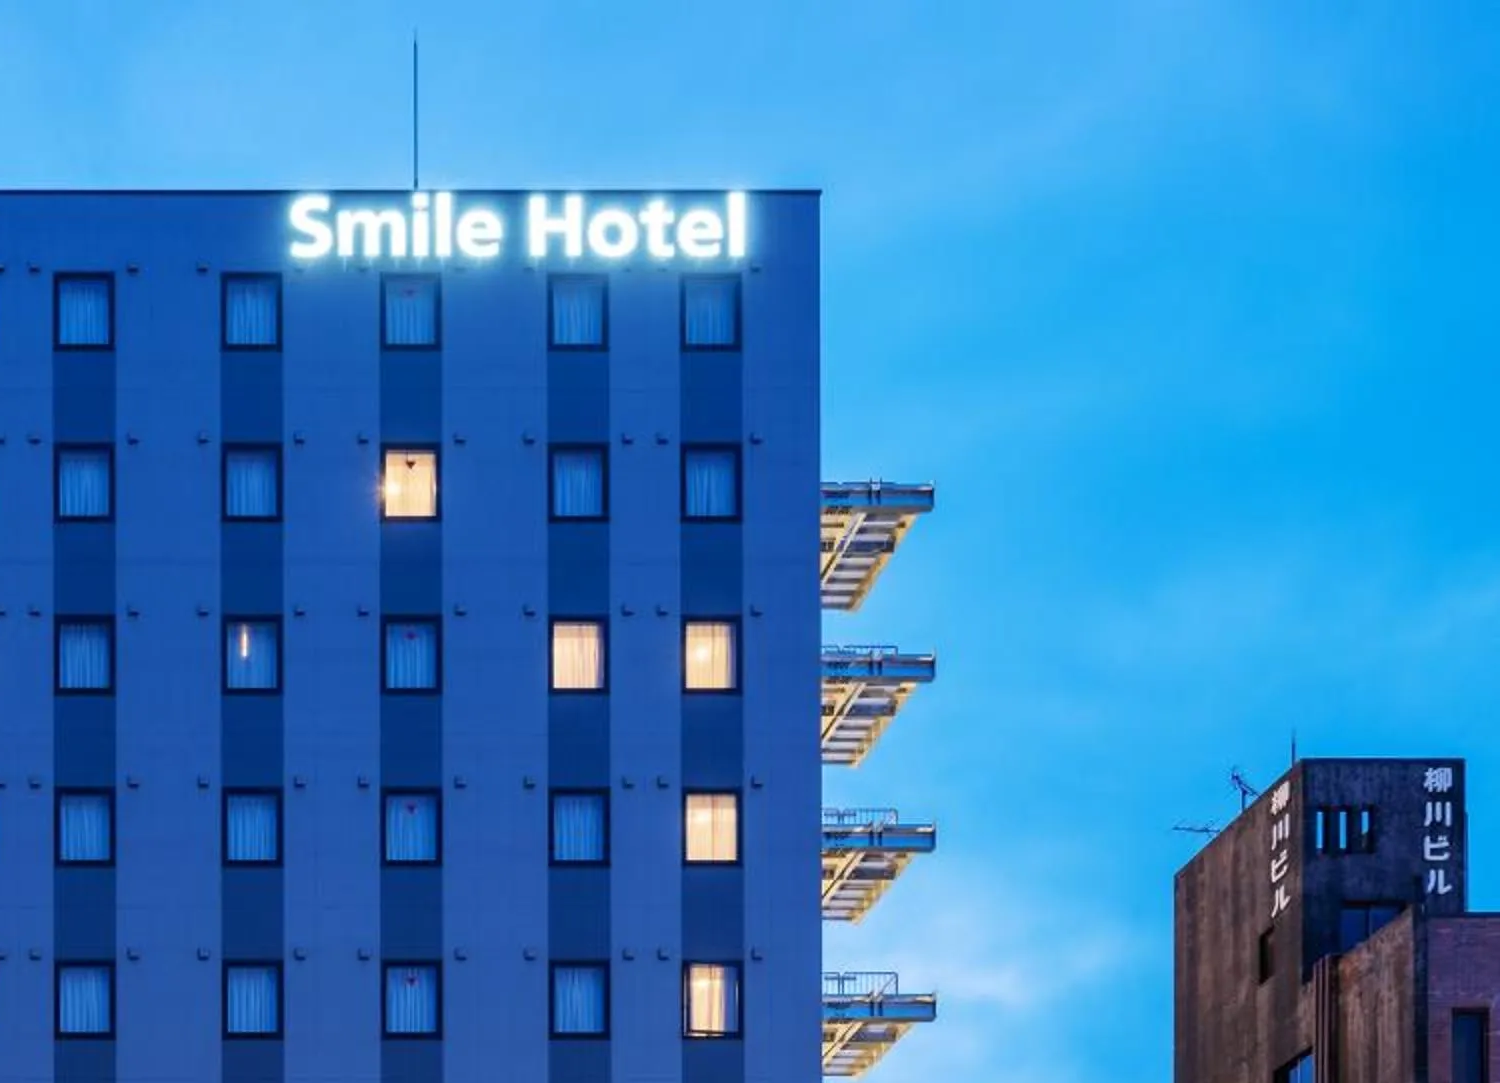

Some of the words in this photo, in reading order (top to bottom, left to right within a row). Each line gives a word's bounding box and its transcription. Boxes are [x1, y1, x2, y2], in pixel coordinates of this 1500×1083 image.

[289, 191, 502, 258] Smile
[527, 191, 747, 258] Hotel
[1270, 780, 1291, 918] 柳川ビル
[1423, 767, 1453, 895] 柳川ビル
